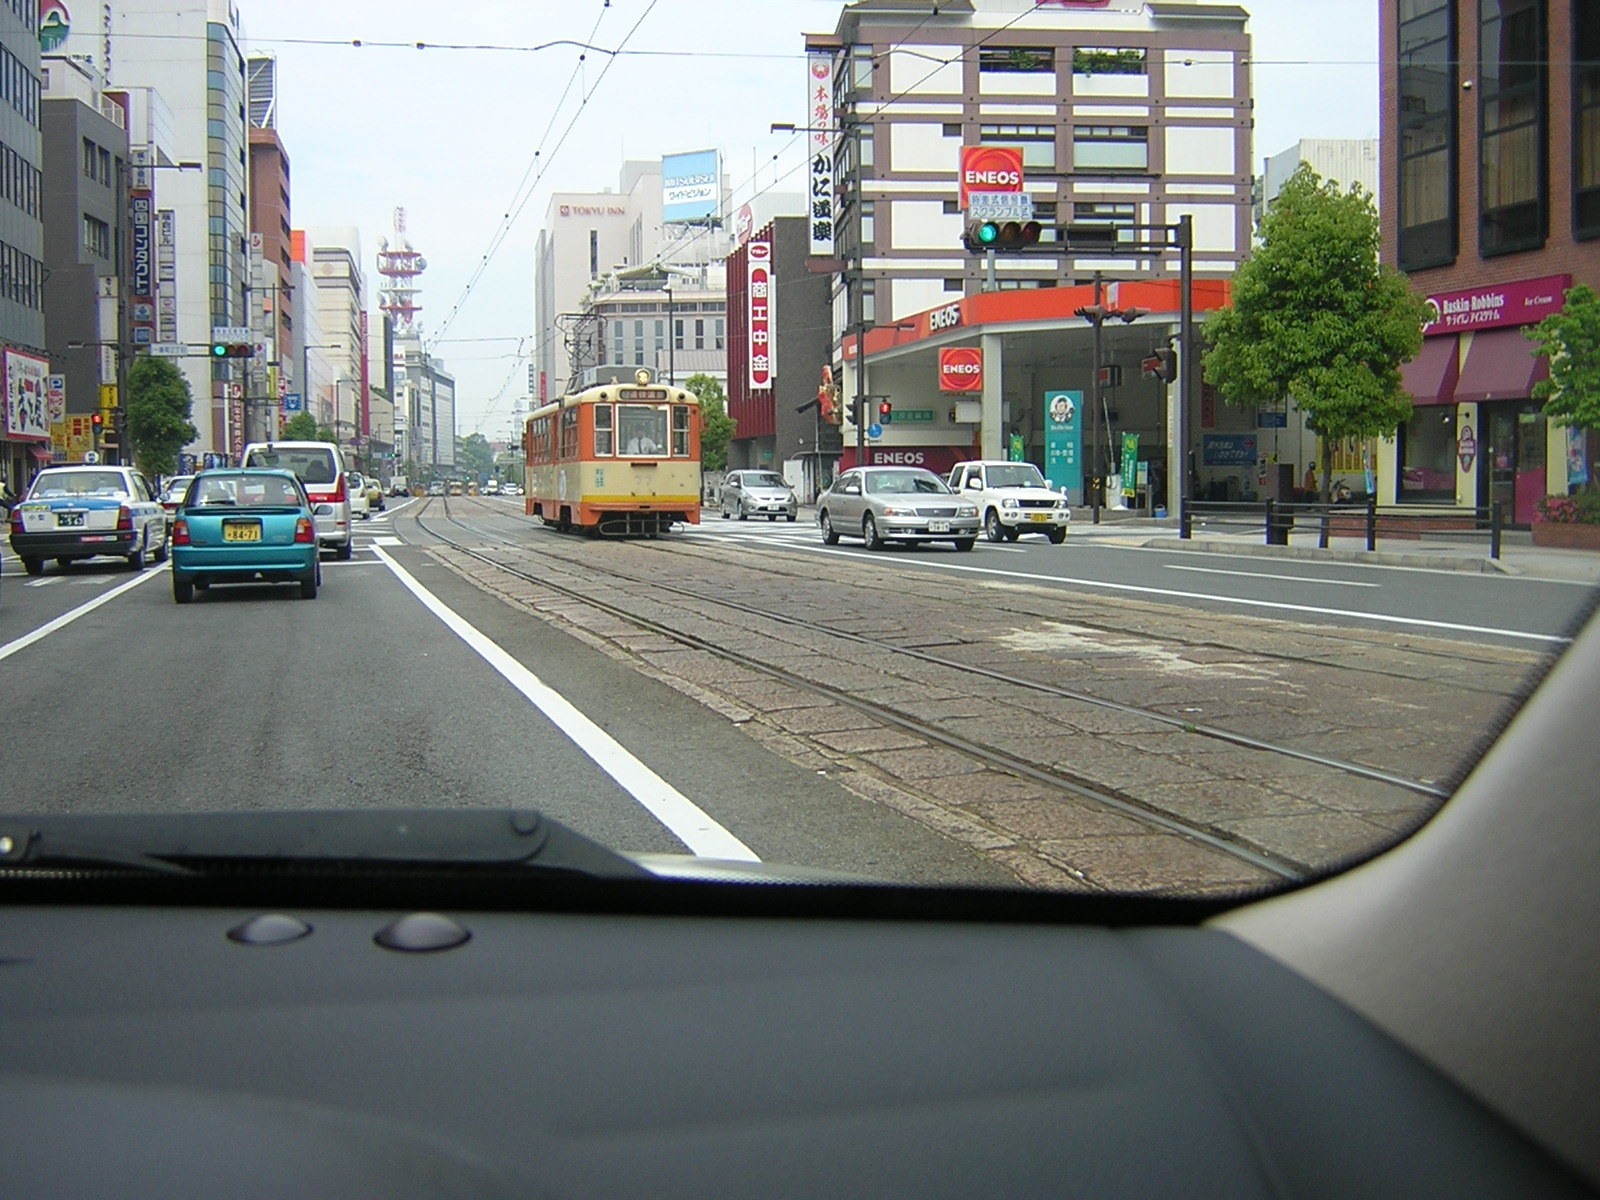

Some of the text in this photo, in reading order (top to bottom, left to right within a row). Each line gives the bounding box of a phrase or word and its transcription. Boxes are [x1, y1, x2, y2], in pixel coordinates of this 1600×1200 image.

[814, 86, 829, 146] 本場の味
[664, 174, 714, 188] MITSUBISHI
[965, 170, 1019, 185] ENEOS
[812, 153, 832, 242] かに道楽
[573, 205, 626, 216] TOKYU INN
[1443, 297, 1469, 314] Baskin
[930, 304, 960, 331] ENEOS
[752, 282, 768, 371] 商工中金
[943, 364, 980, 374] ENEOS
[873, 452, 924, 464] ENEOS
